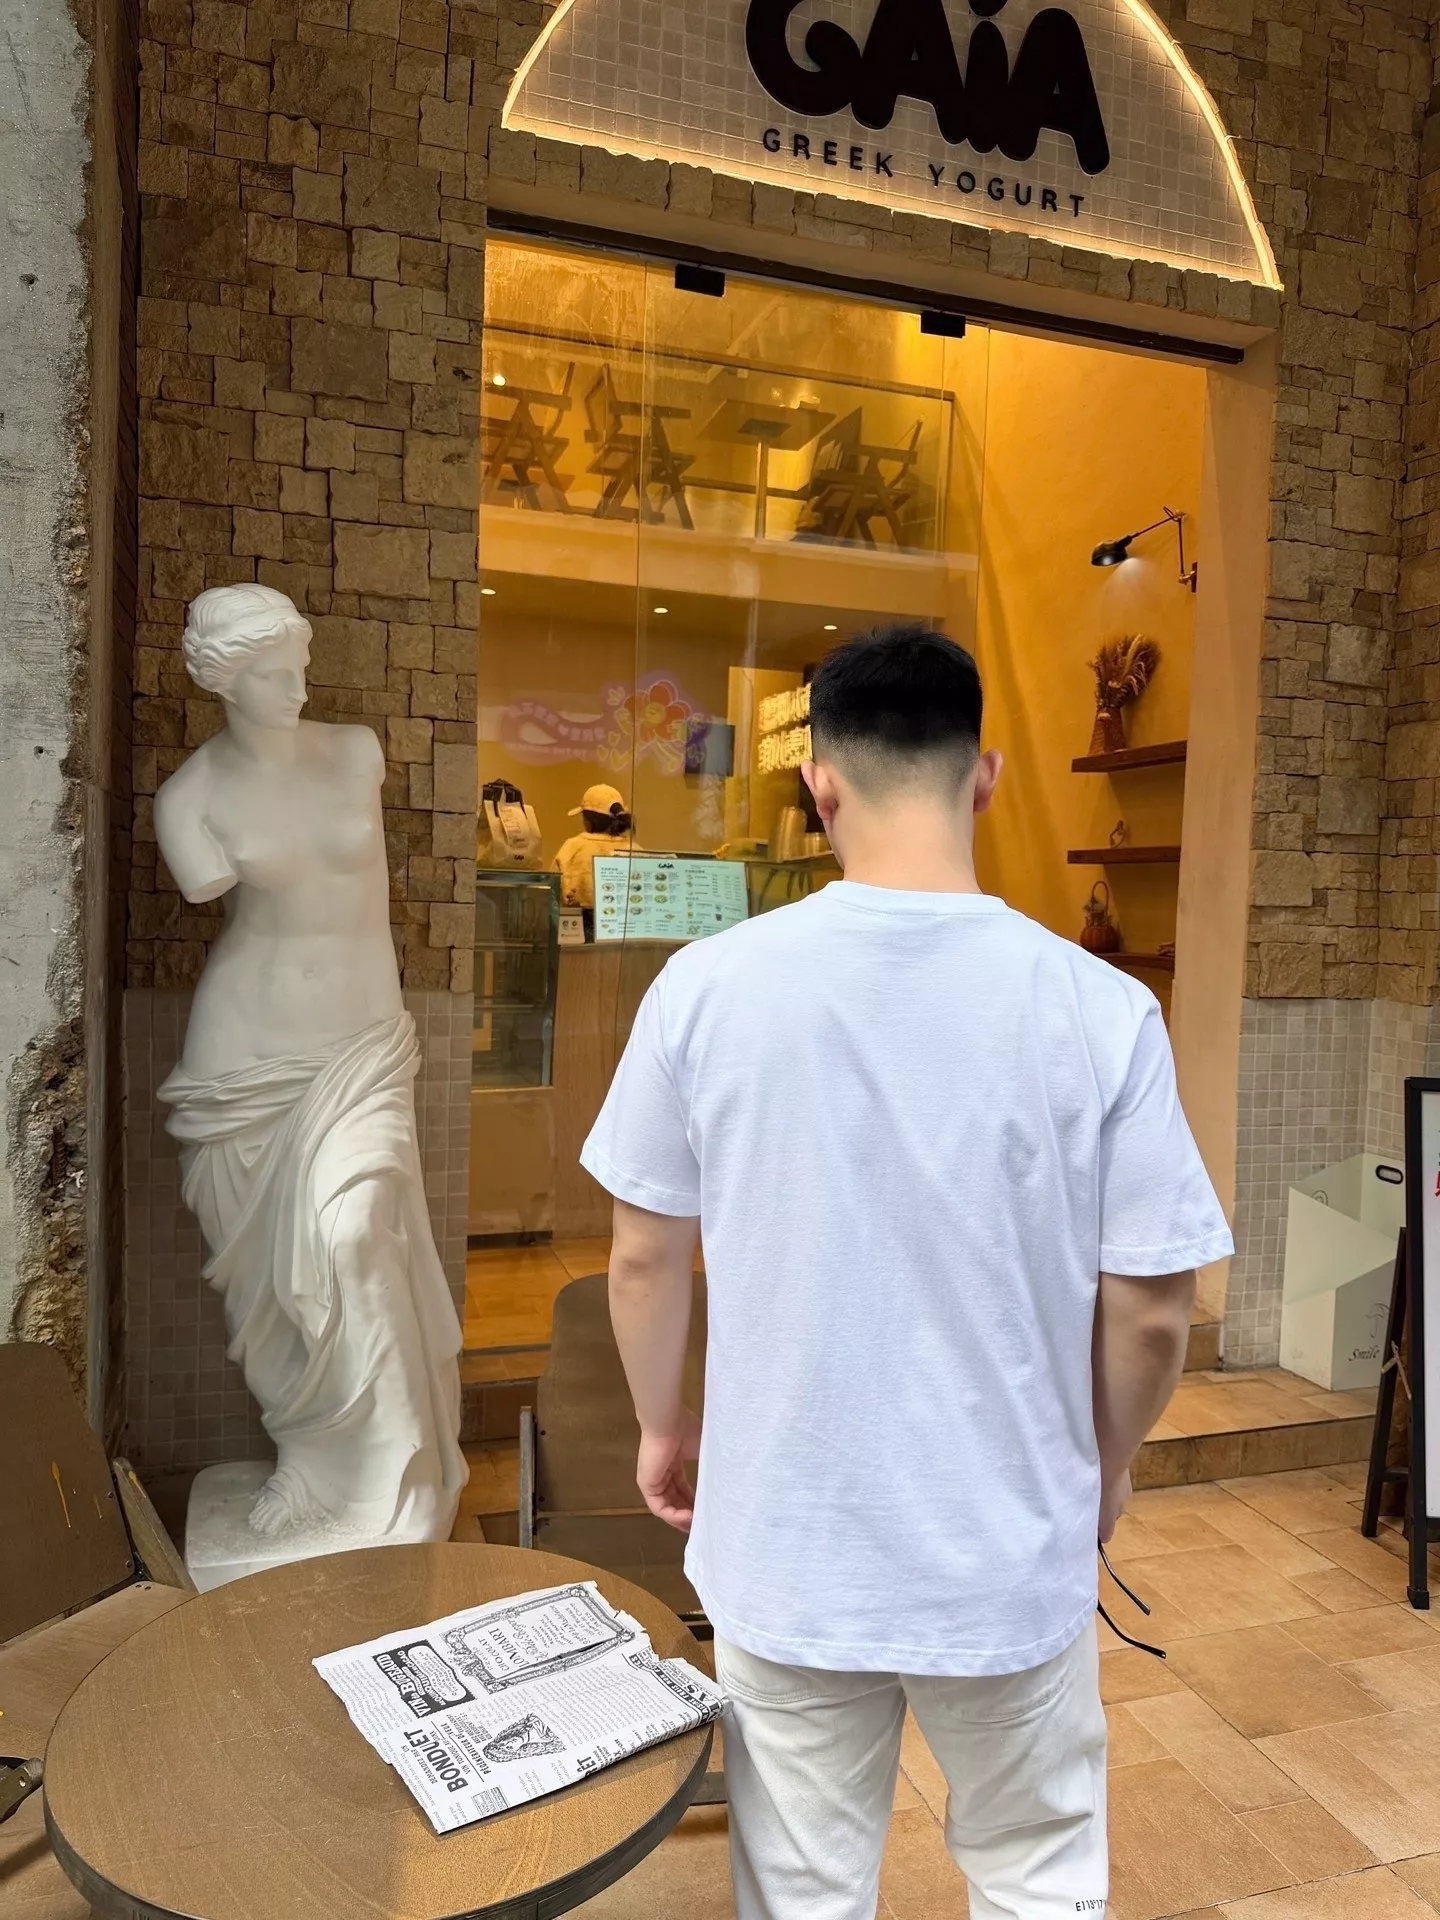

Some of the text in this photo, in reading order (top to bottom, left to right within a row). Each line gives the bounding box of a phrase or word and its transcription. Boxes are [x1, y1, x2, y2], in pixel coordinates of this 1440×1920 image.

[762, 128, 1085, 217] GREEK YOGURT
[1348, 1345, 1380, 1362] Smile
[486, 1627, 530, 1667] LOMBART
[374, 1653, 416, 1695] BUGEAUD
[407, 1696, 431, 1716] VIN
[446, 1744, 464, 1764] TONIQUE
[416, 1757, 438, 1784] DEMANDEZ
[460, 1764, 471, 1774] VIN
